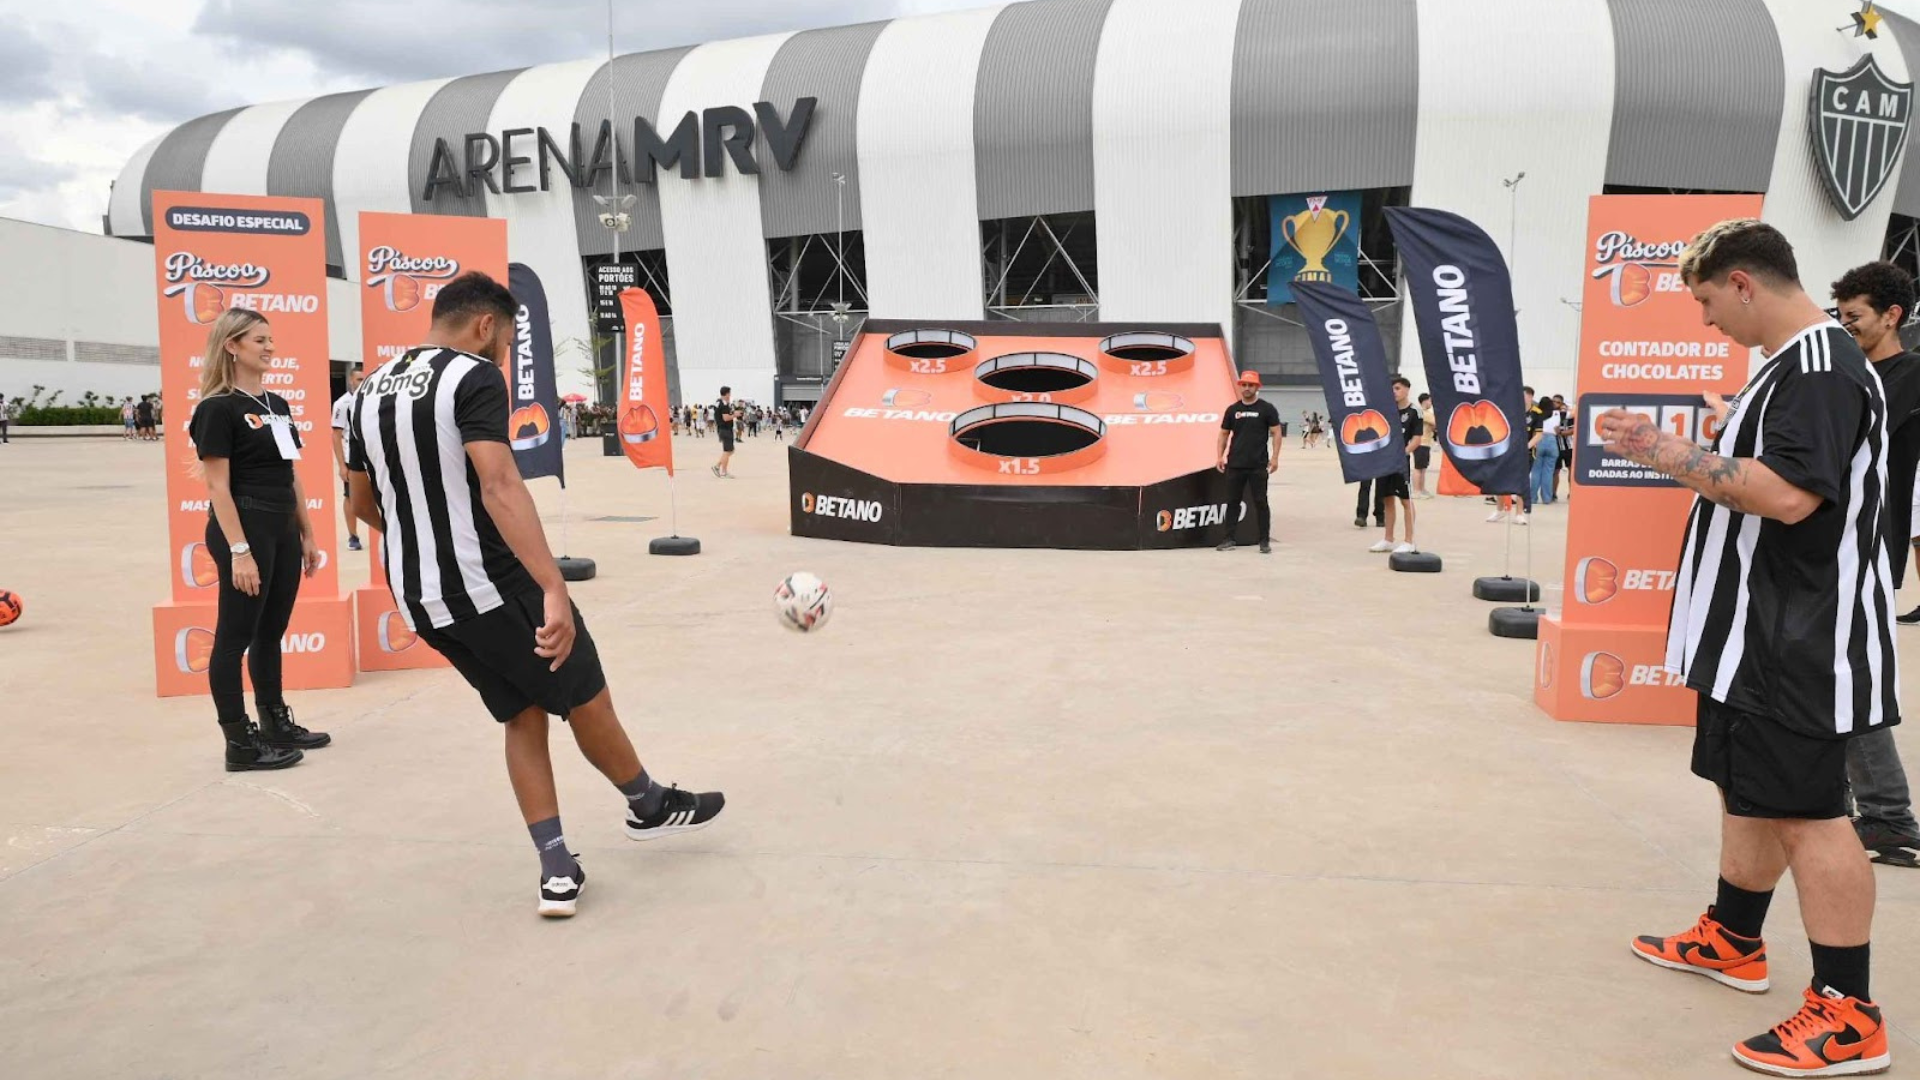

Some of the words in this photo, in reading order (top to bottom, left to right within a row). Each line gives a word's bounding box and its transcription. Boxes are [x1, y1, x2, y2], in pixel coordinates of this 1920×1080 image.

[1833, 86, 1898, 118] CAM
[172, 213, 235, 228] DESAFIO
[236, 216, 303, 230] ESPECIAL
[164, 251, 270, 286] Páscoa
[366, 245, 459, 280] Páscoa
[598, 272, 635, 283] PORTÕES
[230, 293, 319, 314] BETANO
[1432, 264, 1482, 395] BETANO
[514, 304, 535, 400] BETANO
[1599, 341, 1701, 357] CONTADOR
[1704, 343, 1730, 358] DE
[270, 357, 299, 370] OJE,
[629, 322, 645, 401] BETANO
[910, 359, 947, 373] x2.5
[1130, 361, 1167, 376] x2.5
[1325, 318, 1366, 408] BETANO
[1602, 363, 1723, 380] CHOCOLATES
[376, 370, 431, 398] bmg
[844, 407, 957, 422] BETANO
[1103, 412, 1219, 426] BETANO
[998, 458, 1040, 475] x1.5
[1588, 470, 1628, 479] DOADAS
[1629, 470, 1643, 479] AO
[814, 494, 882, 524] BETANO
[1629, 664, 1687, 686] BETA
